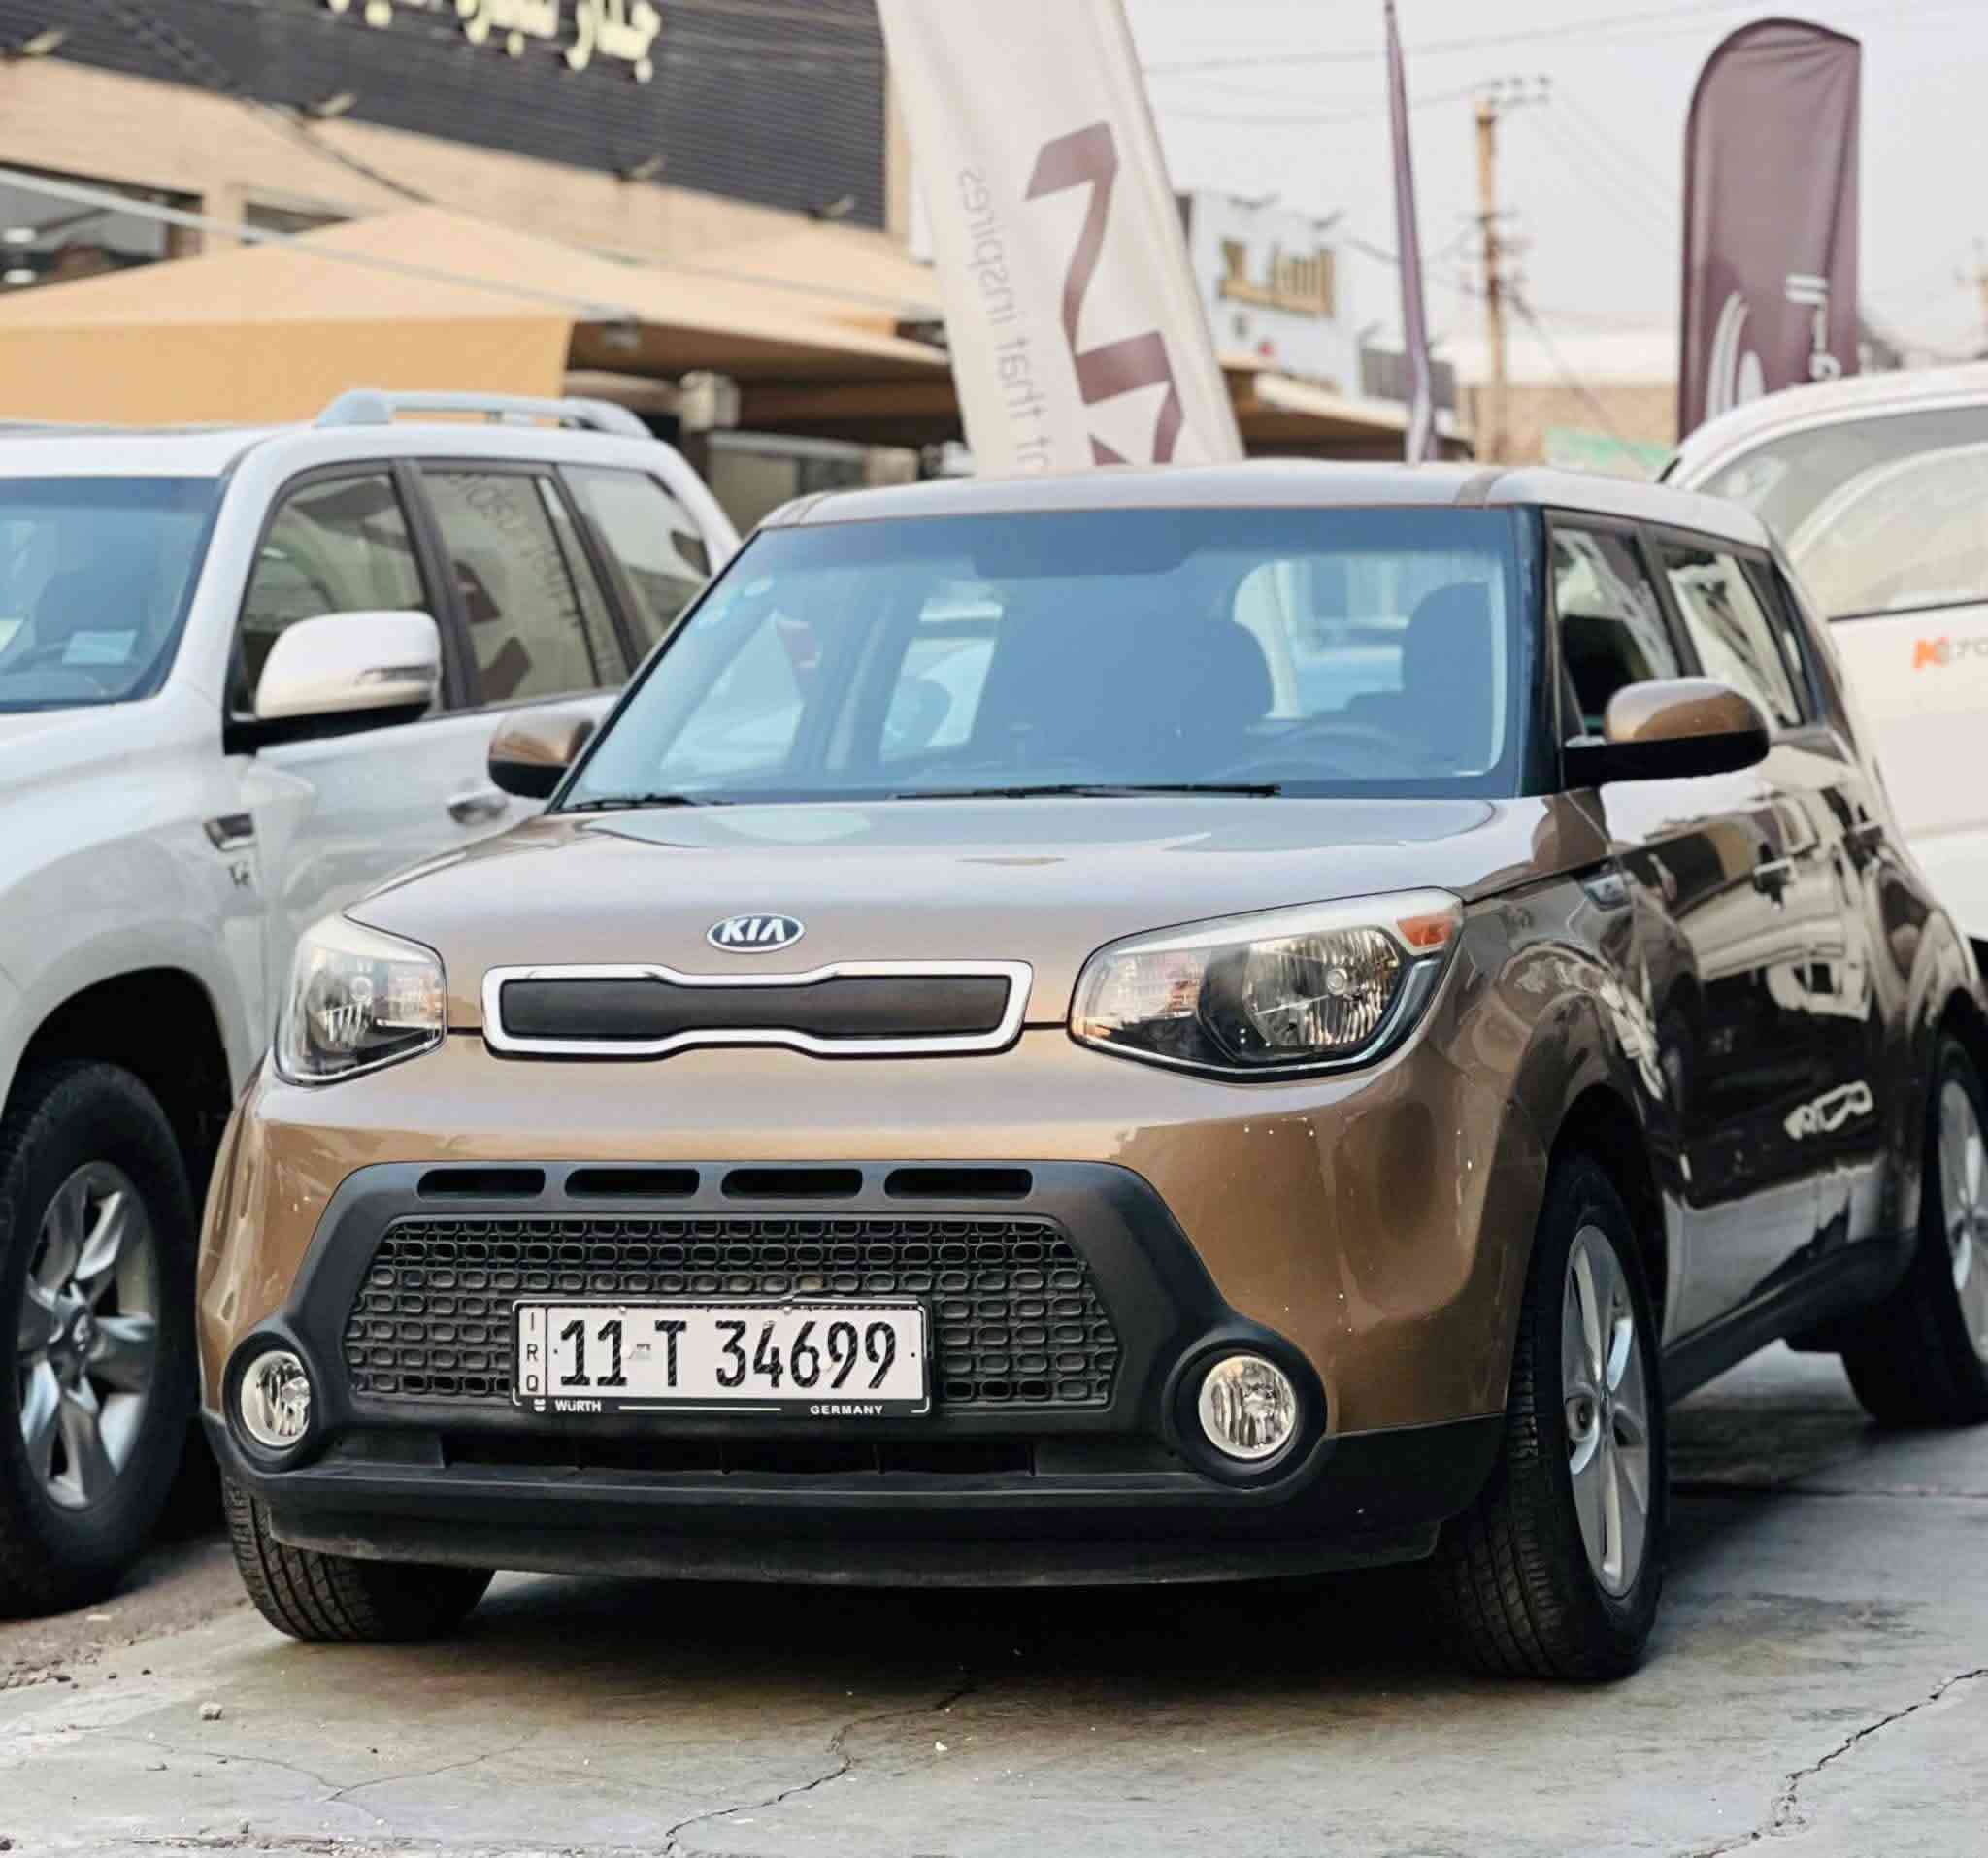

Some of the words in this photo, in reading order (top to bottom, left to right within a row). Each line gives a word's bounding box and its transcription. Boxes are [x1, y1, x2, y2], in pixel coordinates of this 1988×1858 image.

[721, 918, 785, 942] KIA
[560, 1319, 627, 1386] 11
[654, 1320, 687, 1387] T
[715, 1320, 896, 1389] 34699
[810, 1405, 883, 1415] GERMANY
